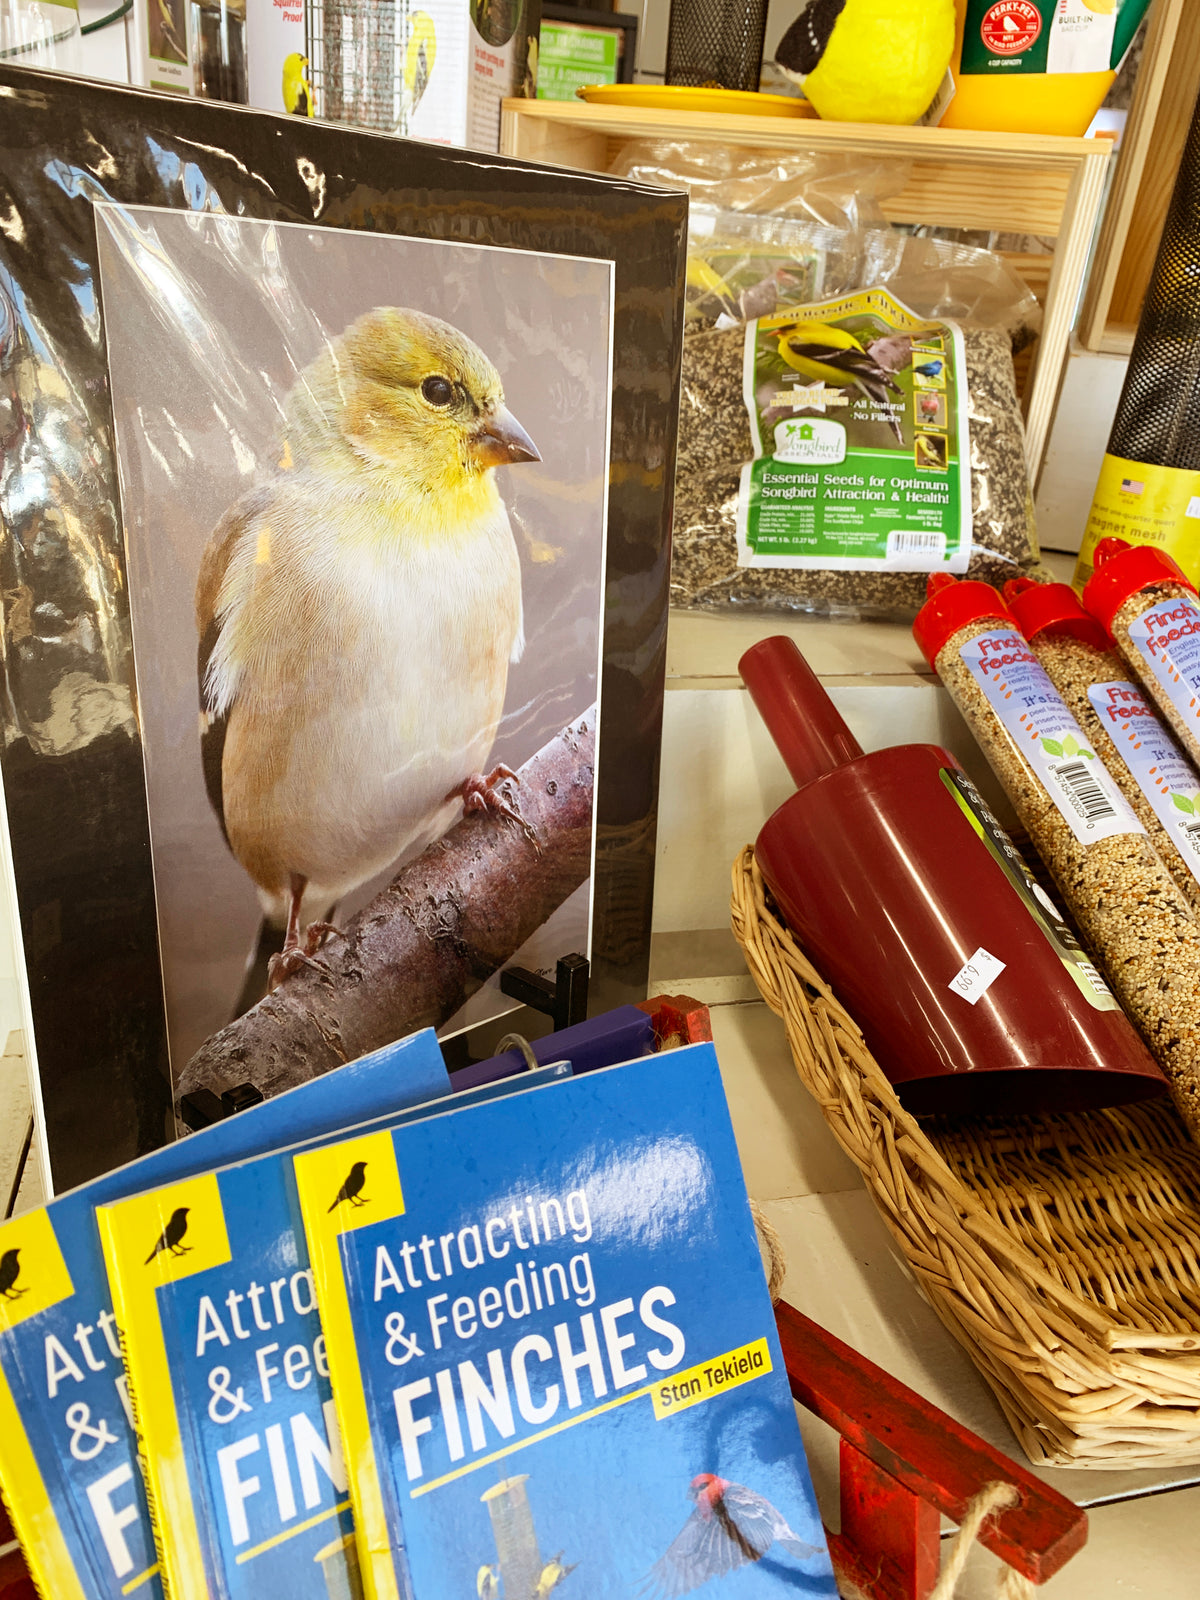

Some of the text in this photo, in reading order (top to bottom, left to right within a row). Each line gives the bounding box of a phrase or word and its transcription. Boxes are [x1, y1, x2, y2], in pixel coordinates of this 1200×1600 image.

[283, 11, 303, 22] Proof
[990, 2, 1035, 20] PERKY-PET
[1058, 16, 1093, 24] BUILT-IN
[854, 400, 905, 412] All Natural
[854, 412, 902, 423] No Fillers
[762, 473, 949, 491] Essential Seeds for Optimum
[762, 486, 949, 504] Songbird Attraction & Health!
[1130, 527, 1167, 542] mesh
[1144, 603, 1198, 634] Finch
[978, 635, 1027, 656] Finch
[1168, 636, 1199, 655] English
[978, 649, 1038, 675] Feede
[1175, 649, 1198, 664] ready
[1014, 683, 1032, 694] easy
[1021, 694, 1047, 708] It's
[1029, 706, 1047, 718] peel
[1034, 715, 1057, 726] insert
[1040, 725, 1062, 735] hang
[1151, 750, 1174, 761] It's
[1048, 763, 1056, 771] 8
[956, 965, 980, 991] 6.99
[373, 1189, 592, 1302] Attracting
[384, 1252, 597, 1366] & Feeding
[392, 1286, 686, 1482] FINCHES
[660, 1349, 763, 1407] Stan Tekiela
[207, 1366, 253, 1424] &
[65, 1402, 119, 1461] &
